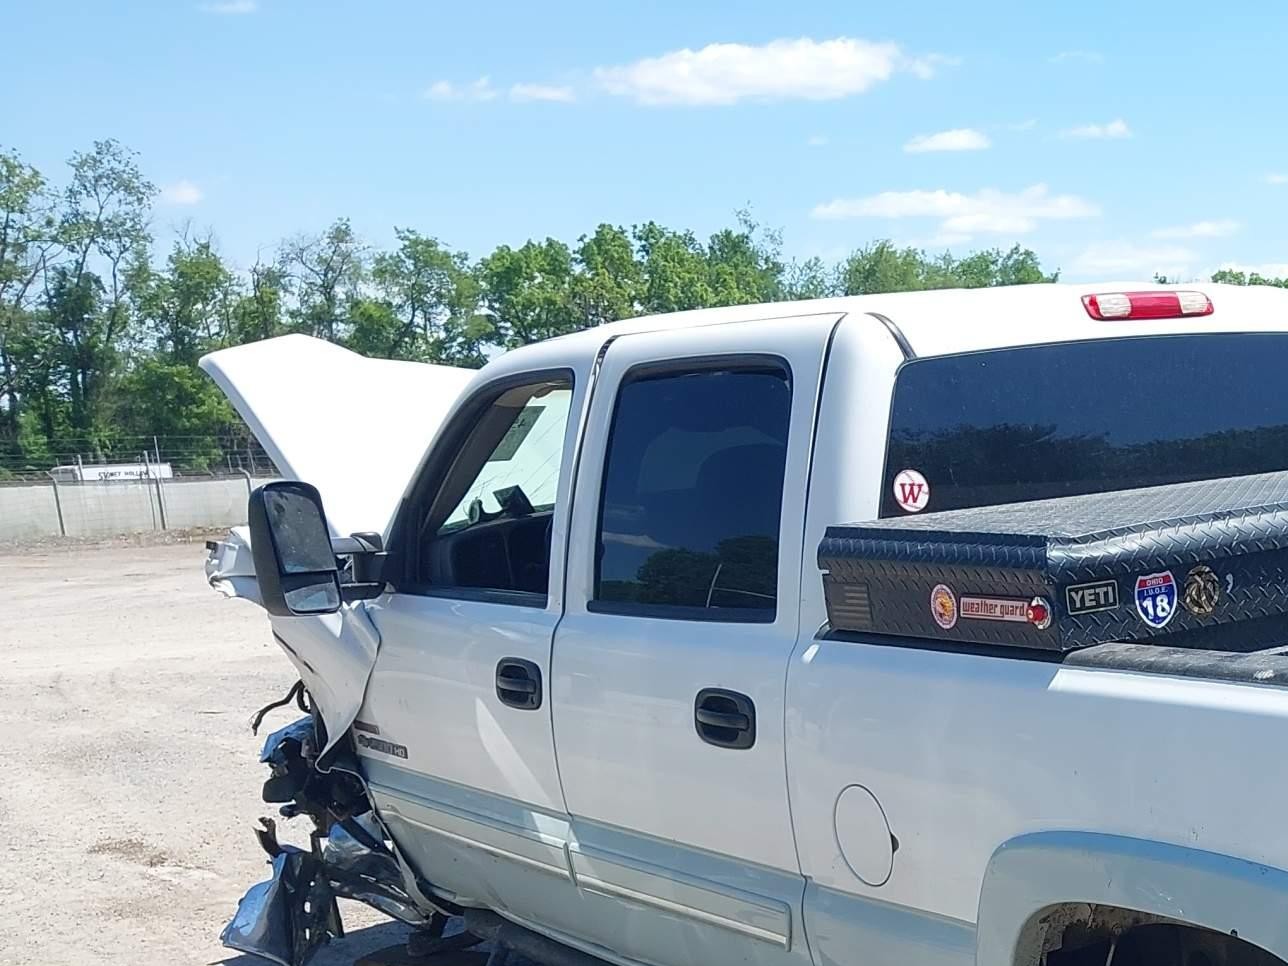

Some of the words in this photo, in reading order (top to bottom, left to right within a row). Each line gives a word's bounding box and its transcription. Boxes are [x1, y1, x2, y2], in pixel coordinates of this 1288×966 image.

[899, 483, 925, 504] W
[1146, 577, 1164, 586] OHIO
[962, 599, 998, 614] weather
[1070, 586, 1114, 608] YETI
[1142, 594, 1170, 619] 18
